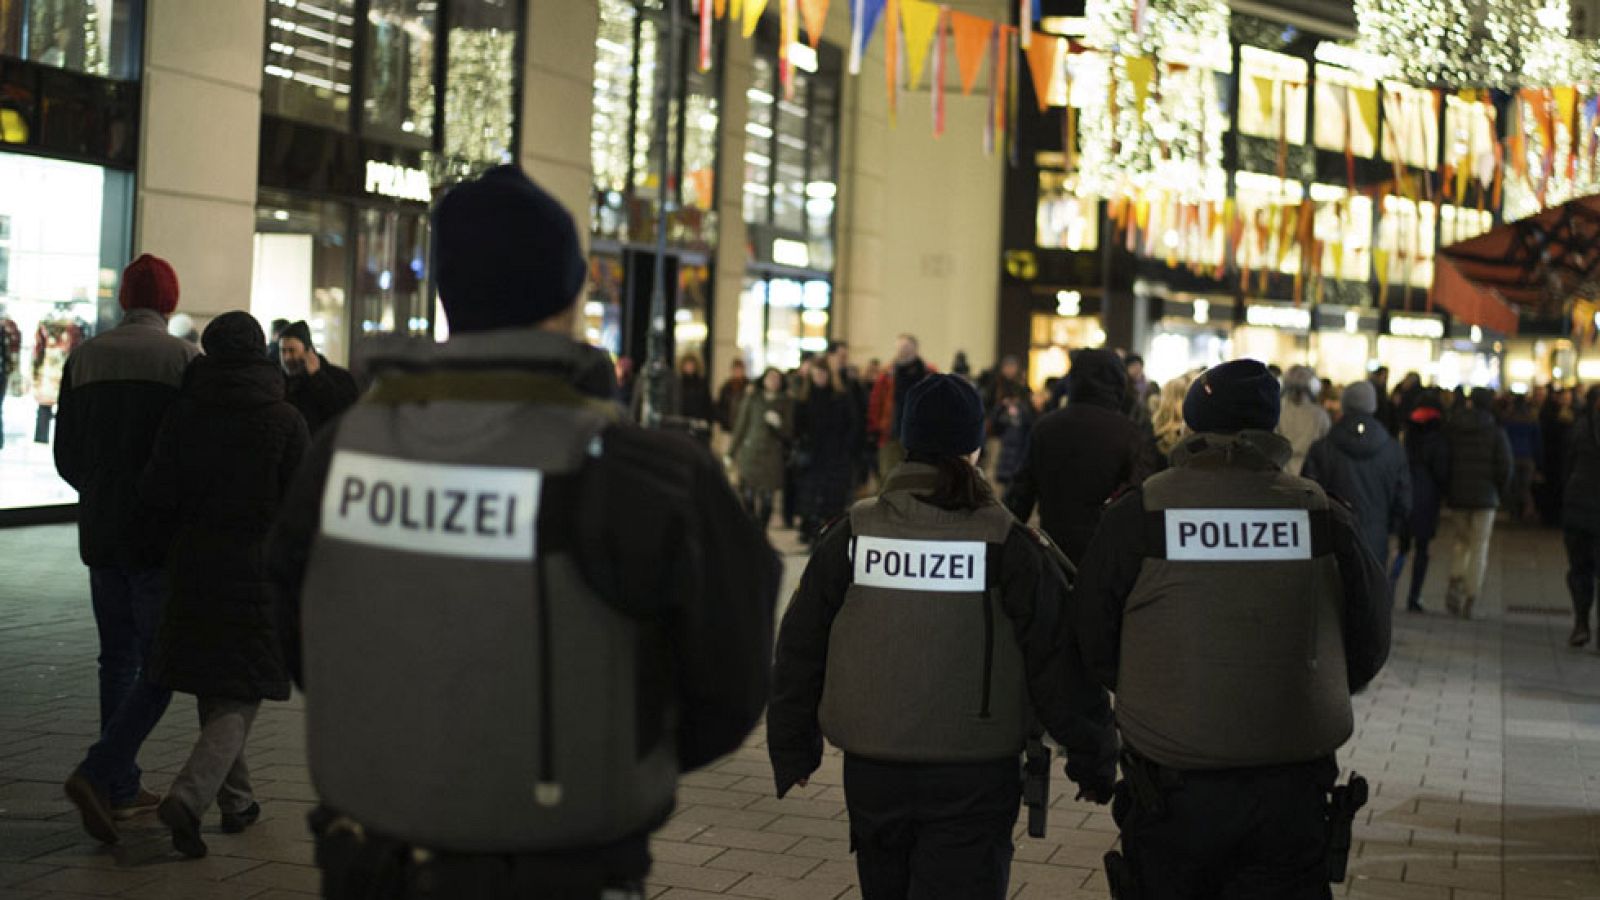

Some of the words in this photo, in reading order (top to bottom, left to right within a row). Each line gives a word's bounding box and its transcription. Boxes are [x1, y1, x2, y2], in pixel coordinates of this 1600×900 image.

[339, 475, 518, 537] POLIZEI
[1178, 520, 1299, 548] POLIZEI
[865, 548, 974, 579] POLIZEI
